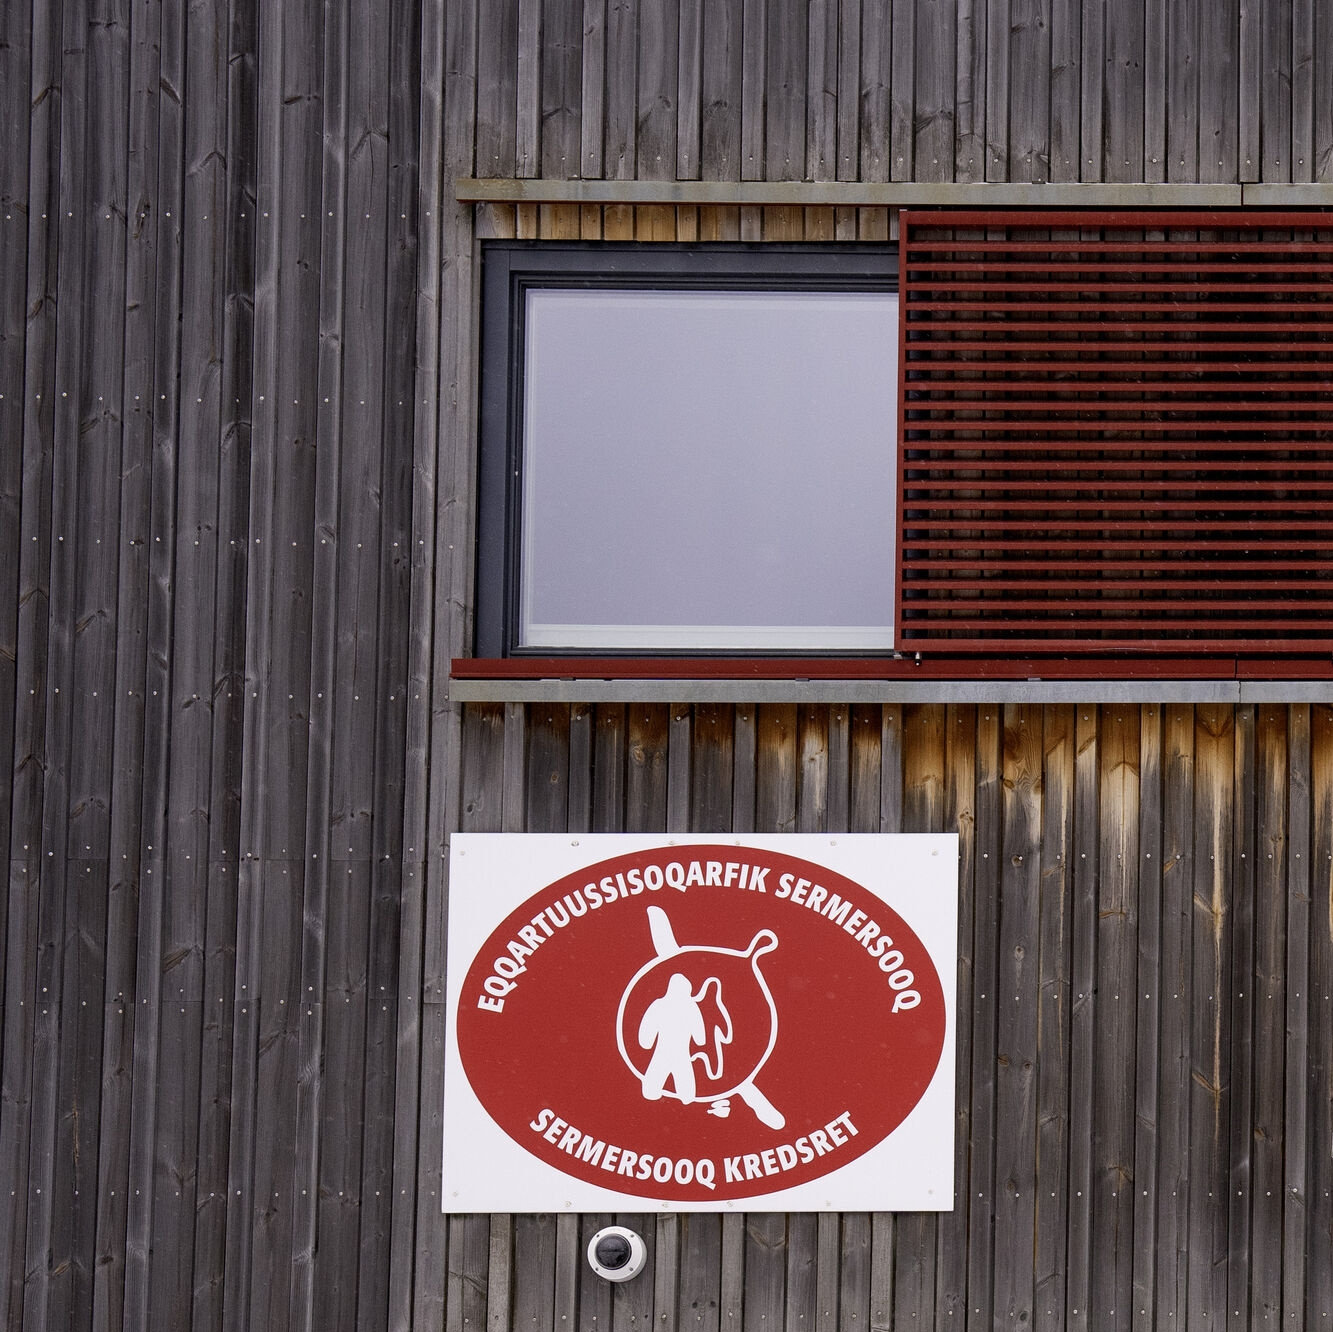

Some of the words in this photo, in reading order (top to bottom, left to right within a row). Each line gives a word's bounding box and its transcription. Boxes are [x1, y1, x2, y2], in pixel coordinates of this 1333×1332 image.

[477, 860, 771, 1014] EQQARTUUSSISOQARFIK
[774, 872, 922, 1014] SERMERSOOQ
[529, 1108, 716, 1190] SERMERSOOQ
[724, 1111, 860, 1184] KREDSRET
